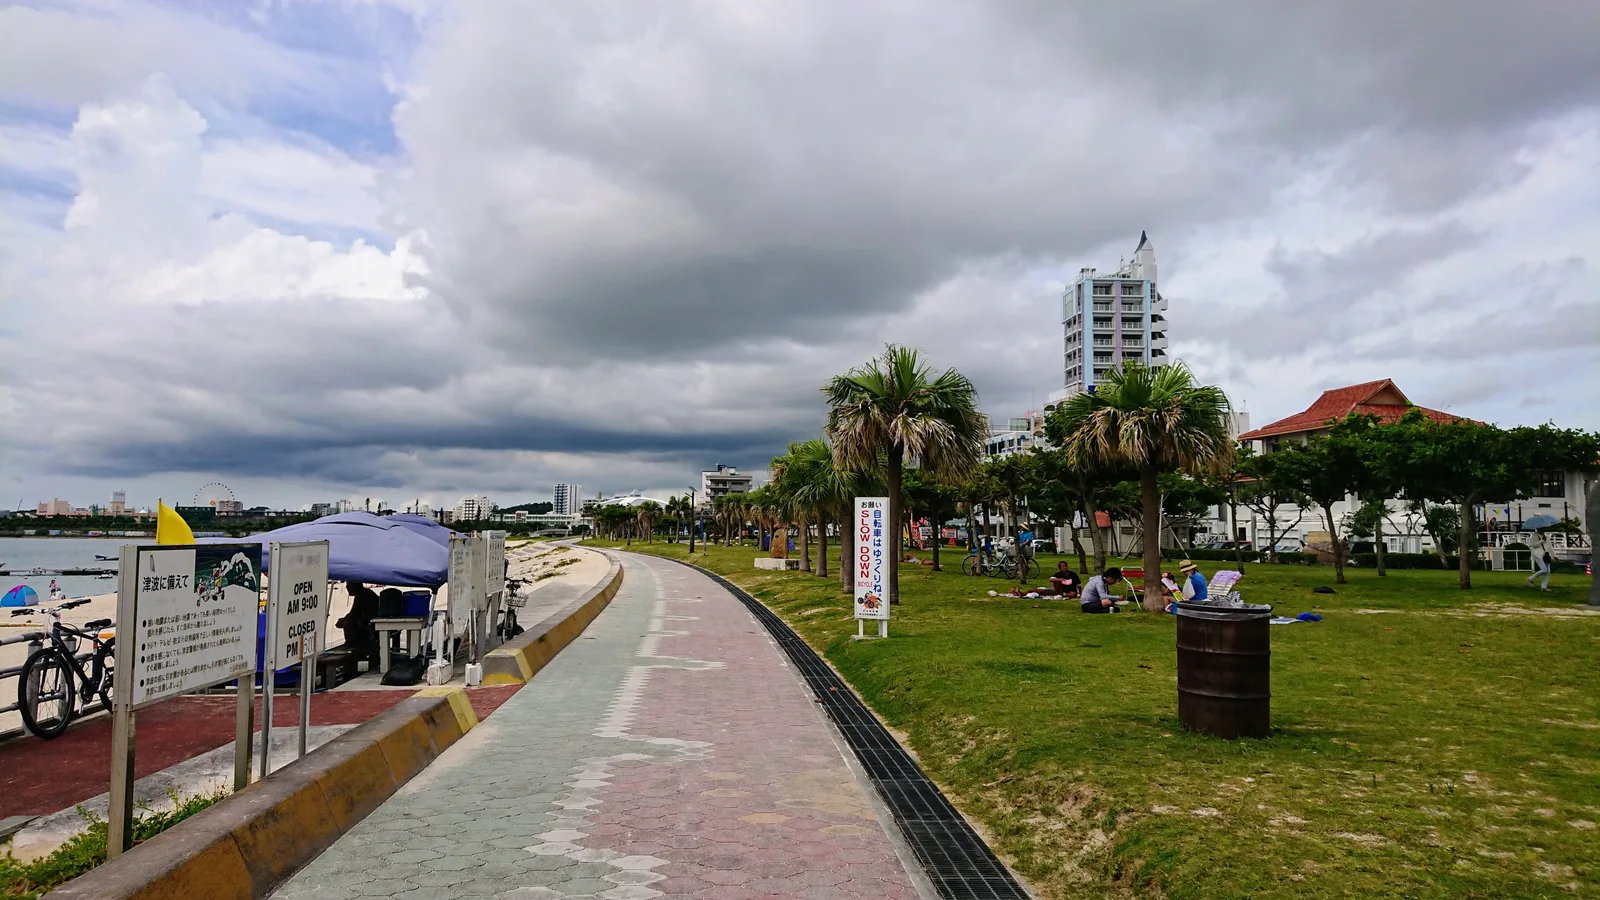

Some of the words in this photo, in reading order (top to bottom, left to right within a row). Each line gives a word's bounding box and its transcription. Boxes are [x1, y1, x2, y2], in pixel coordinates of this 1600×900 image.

[860, 509, 870, 542] SLOW
[860, 546, 870, 578] DOWN
[142, 574, 189, 592] 津波に備えて
[293, 580, 313, 596] OPEN
[286, 599, 300, 615] AM
[301, 594, 318, 611] 9:00
[288, 620, 316, 639] CLOSED
[286, 641, 299, 658] PM
